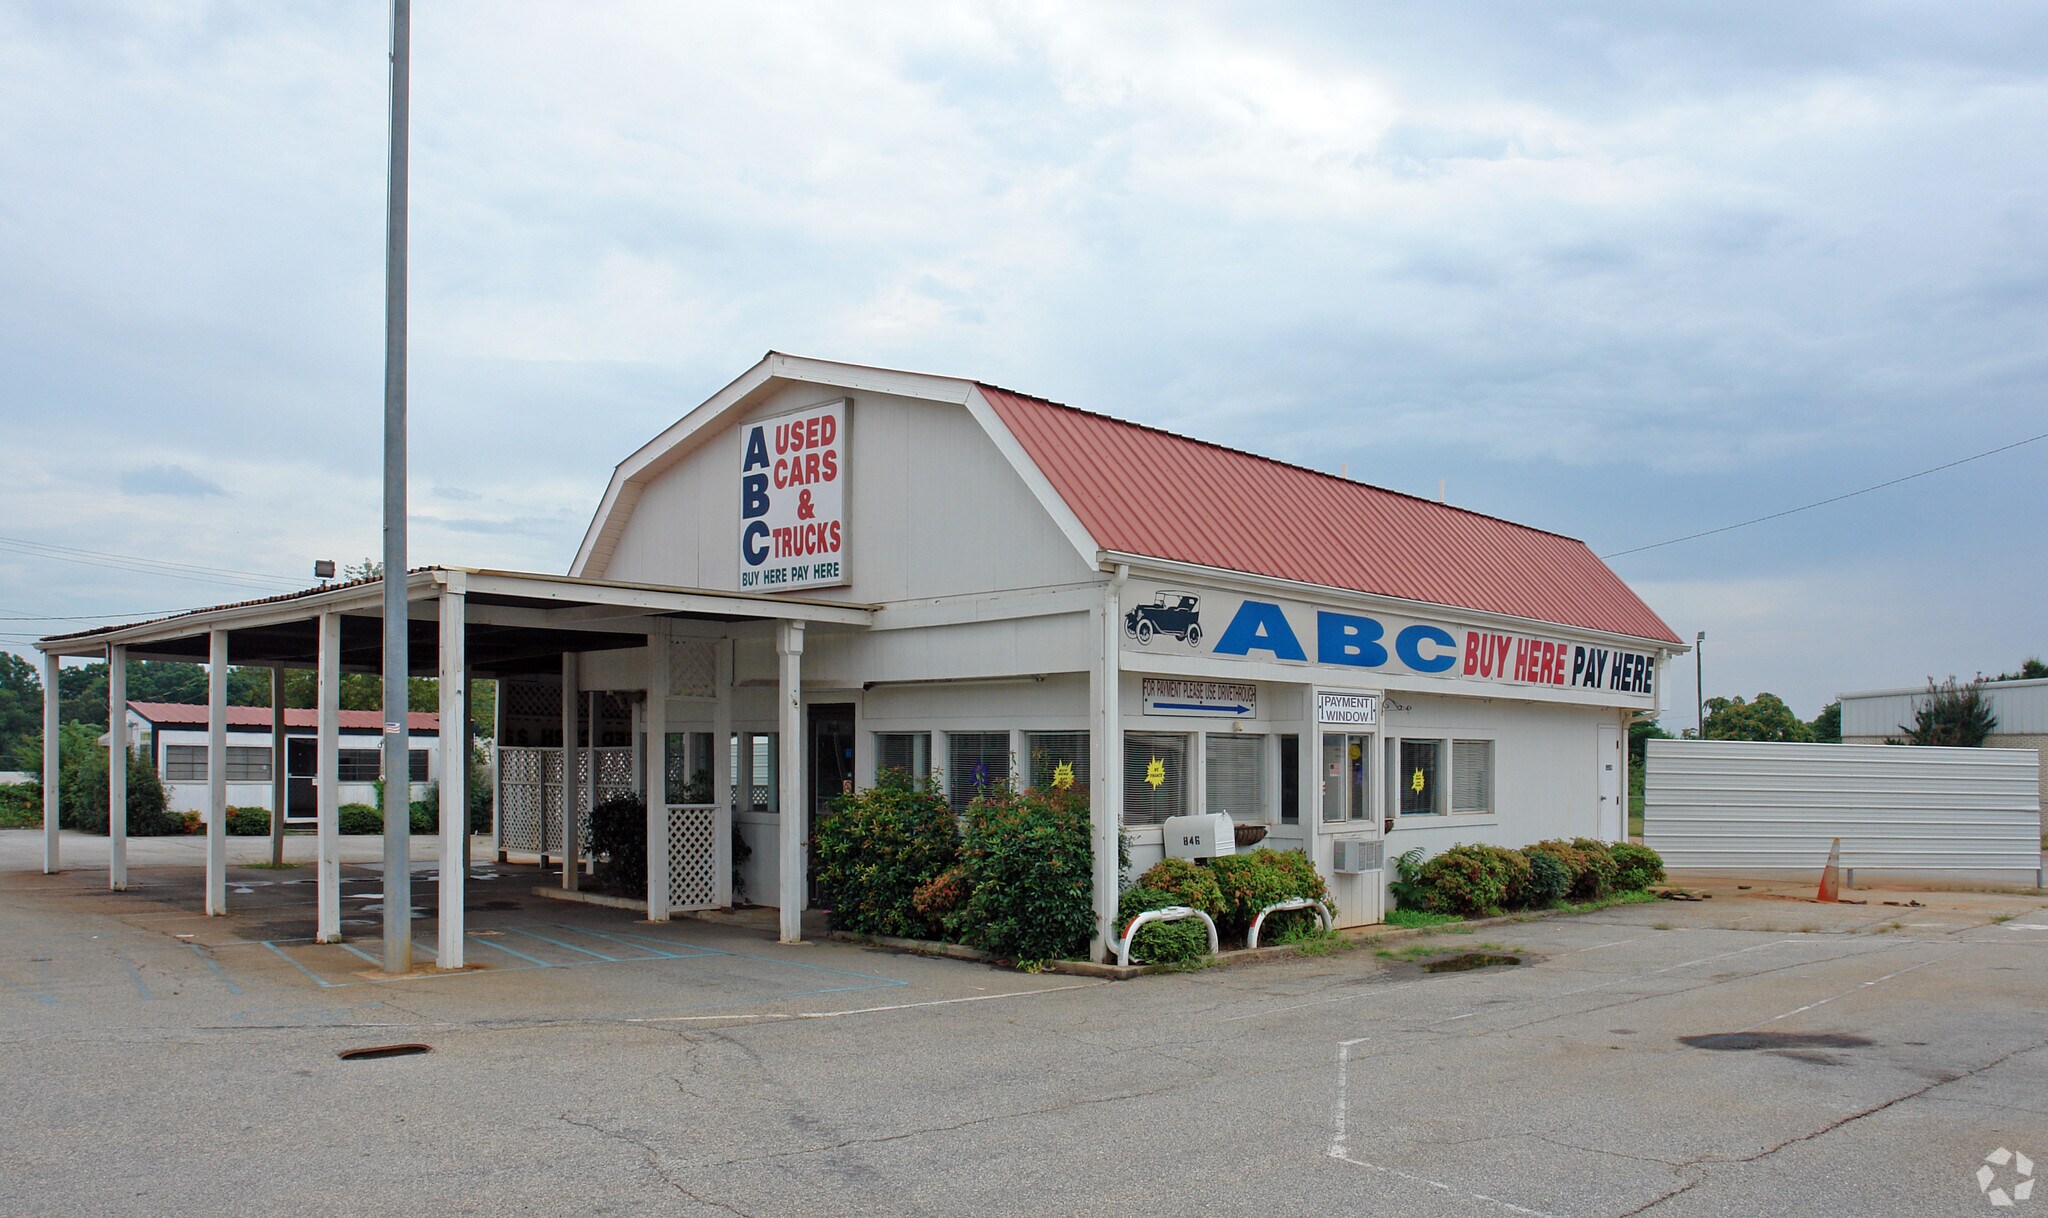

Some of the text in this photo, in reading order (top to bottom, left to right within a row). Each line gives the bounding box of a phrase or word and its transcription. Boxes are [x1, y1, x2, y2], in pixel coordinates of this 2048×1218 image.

[775, 414, 837, 455] USED
[774, 449, 837, 490] CARS
[797, 488, 815, 520] &
[772, 520, 841, 558] TRUCKS
[742, 562, 839, 586] BUY HERE PAY HERE
[1212, 600, 1457, 673] ABC
[1463, 631, 1655, 693] BUY HERE PAY HERE
[1143, 680, 1155, 697] FOR
[1157, 680, 1181, 698] PAYMENT
[1184, 682, 1203, 699] PLEASE
[1205, 684, 1216, 700] USE
[1324, 696, 1369, 708] PAYMENT
[1326, 710, 1369, 722] WINDOW
[1183, 835, 1200, 846] 846
